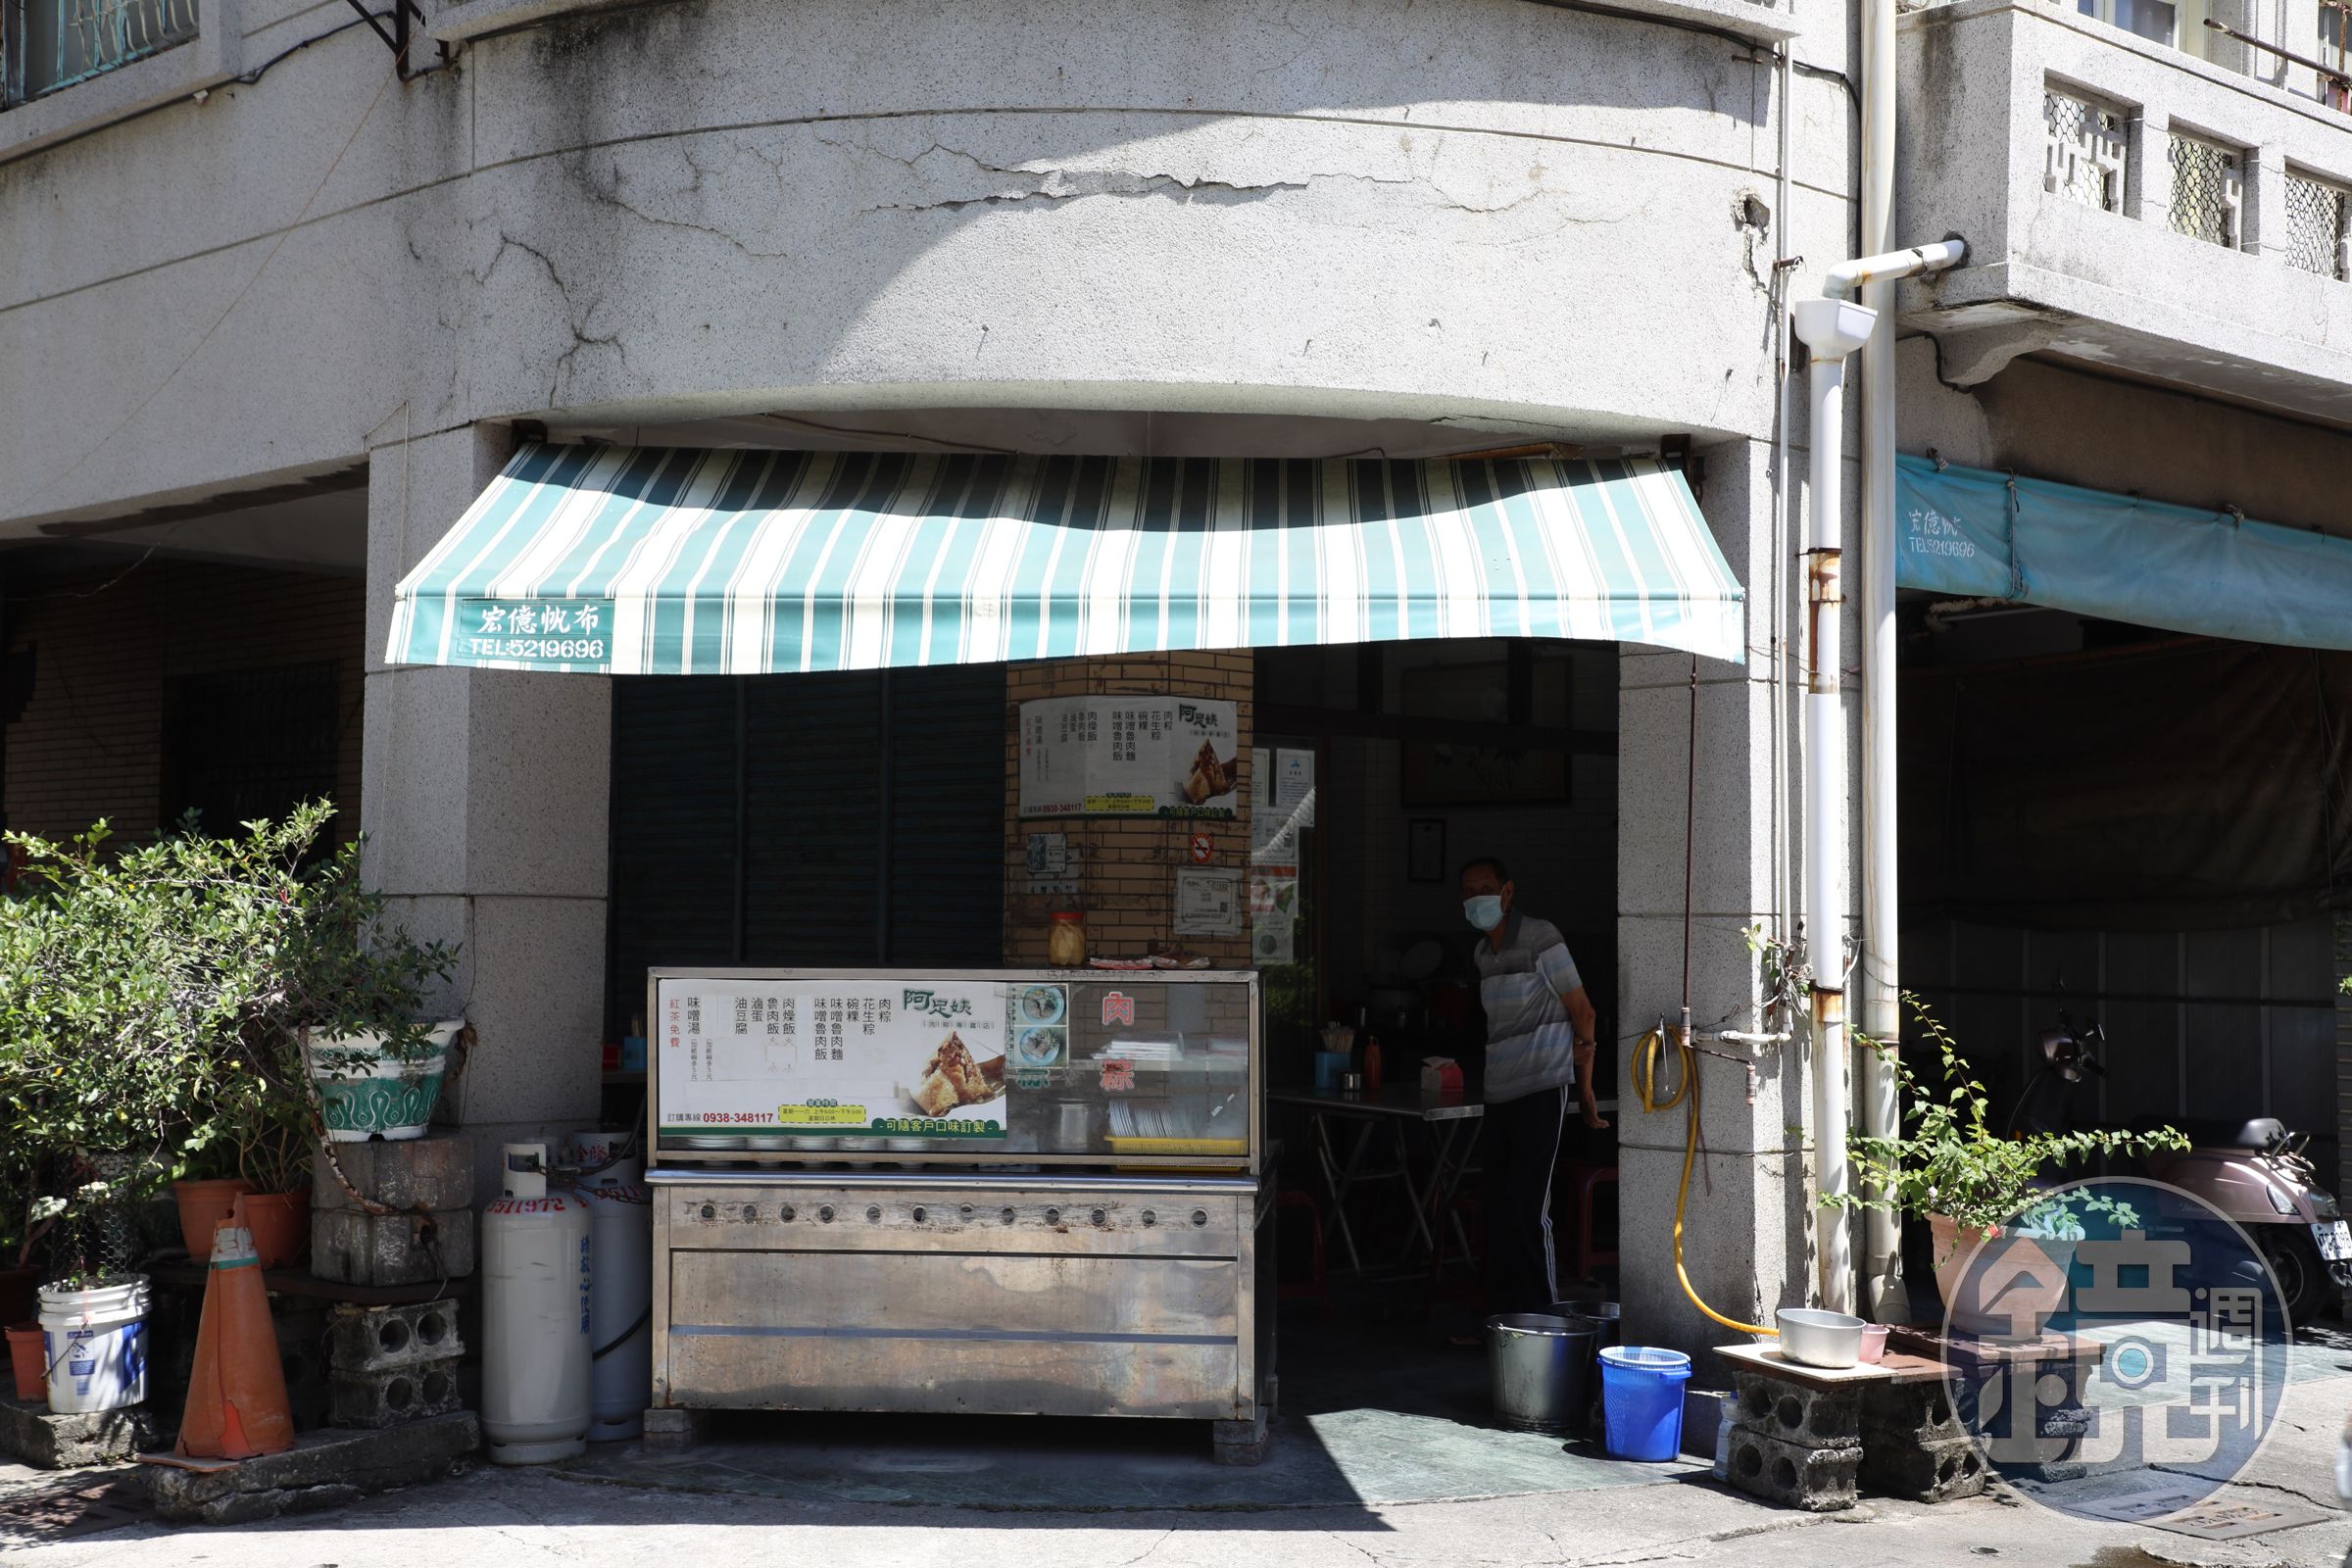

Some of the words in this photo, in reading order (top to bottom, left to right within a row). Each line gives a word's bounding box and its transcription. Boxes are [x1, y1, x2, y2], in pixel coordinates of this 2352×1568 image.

[477, 604, 600, 635] 宏億帆布
[469, 638, 604, 659] TEL:5219696
[669, 999, 680, 1048] 紅茶免費
[687, 997, 701, 1035] 味噌湯
[735, 997, 748, 1035] 油豆腐
[751, 997, 763, 1022] 滷蛋
[767, 997, 779, 1035] 魯肉飯
[783, 998, 796, 1035] 肉燥飯
[847, 998, 859, 1022] 碗粿
[862, 998, 875, 1035] 花生粽
[878, 998, 892, 1022] 肉粽
[814, 998, 827, 1060] 味噌魯肉飯
[831, 998, 844, 1060] 味噌魯肉麵
[703, 1112, 774, 1123] 0938-348117
[886, 1119, 986, 1133] 可隨客戶口味訂製
